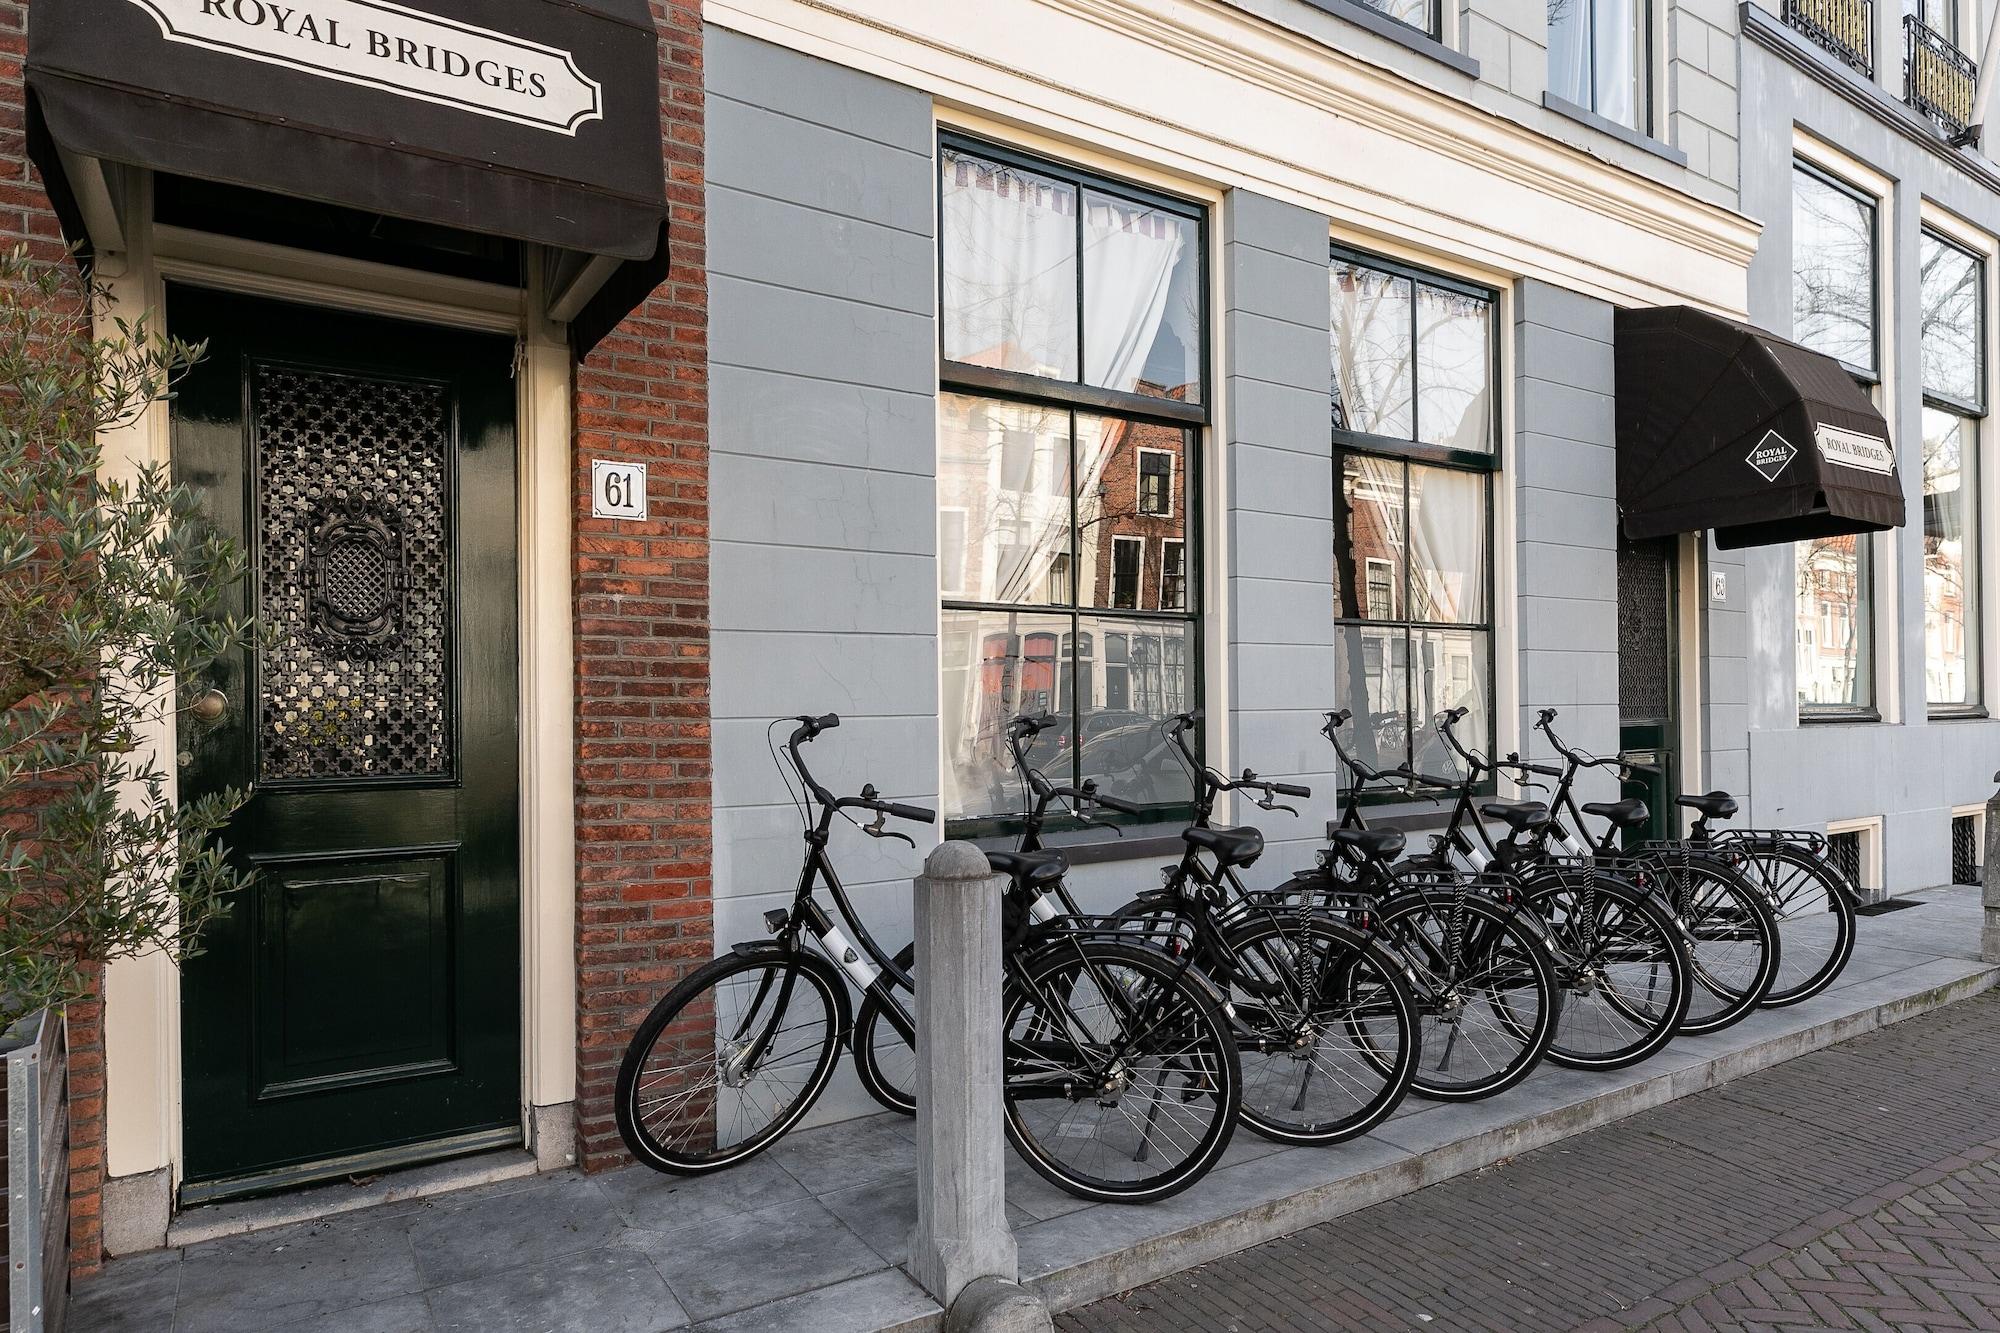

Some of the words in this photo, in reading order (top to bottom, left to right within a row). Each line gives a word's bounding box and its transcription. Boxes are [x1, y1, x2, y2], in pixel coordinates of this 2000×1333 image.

[366, 29, 547, 99] BRIDGES
[1756, 446, 1787, 459] ROYAL
[1756, 454, 1787, 466] BRIDGES
[1825, 437, 1852, 455] ROYAL
[1852, 444, 1885, 462] BRIDGES
[605, 472, 634, 508] 61
